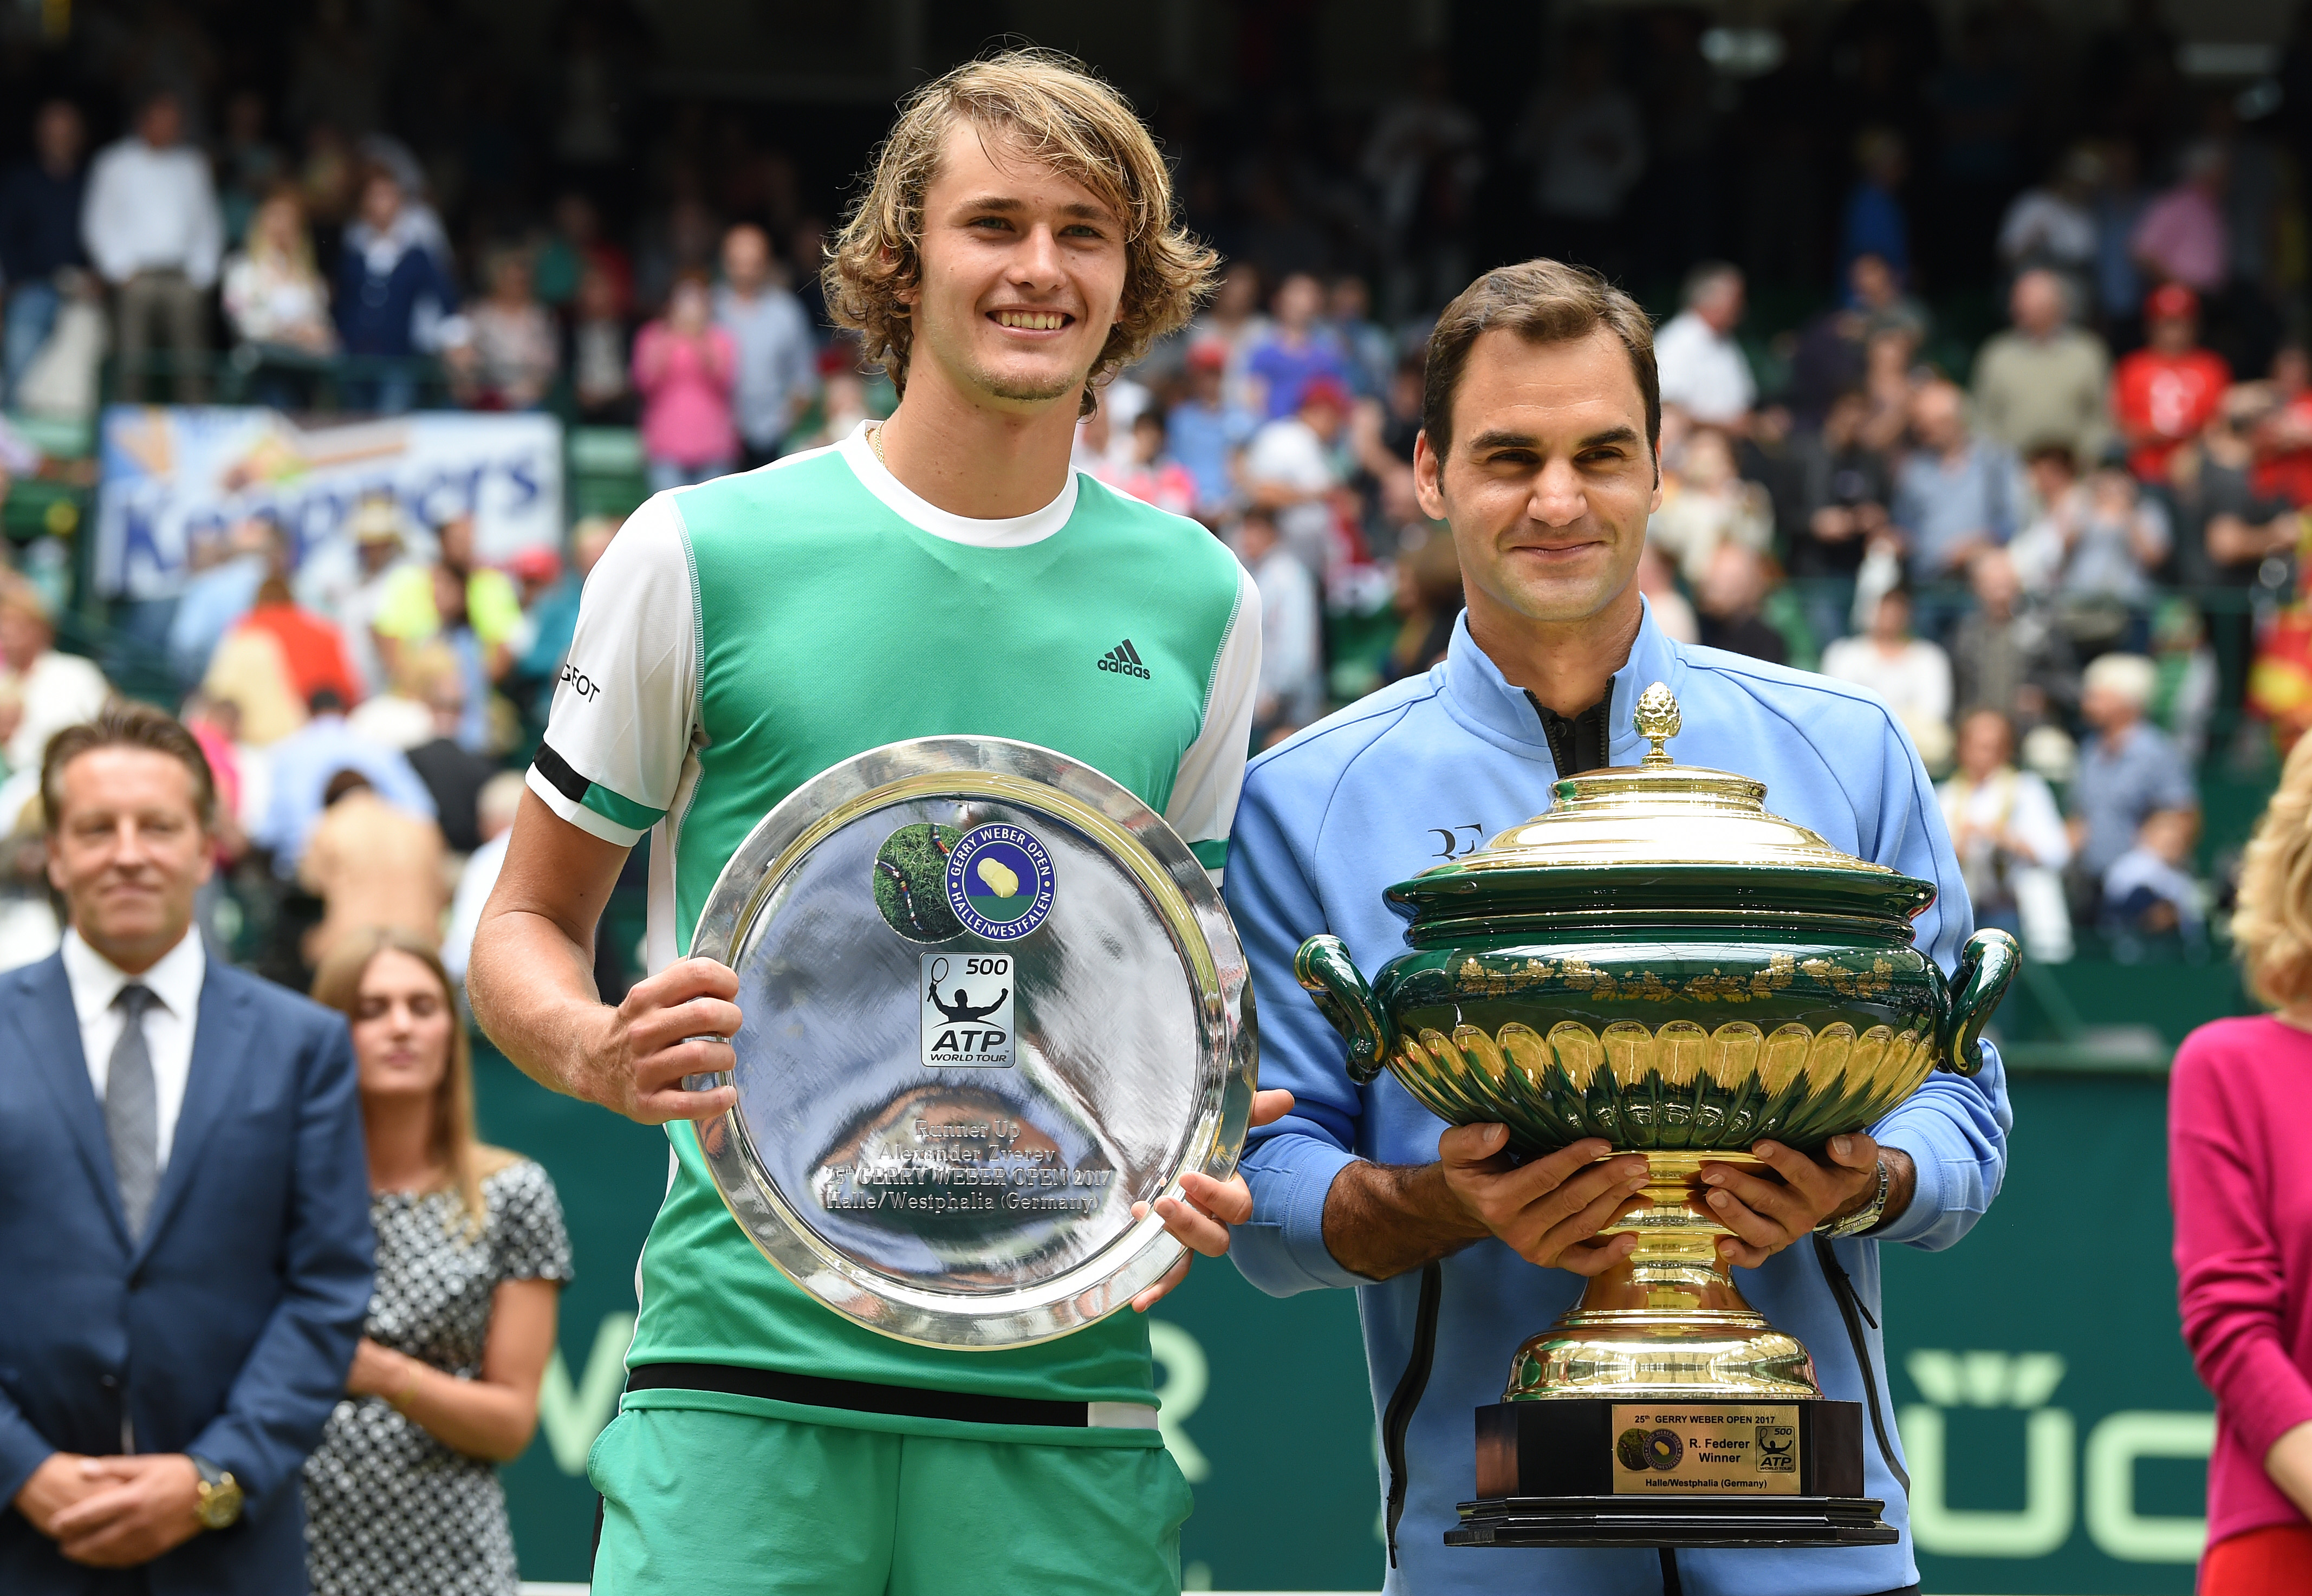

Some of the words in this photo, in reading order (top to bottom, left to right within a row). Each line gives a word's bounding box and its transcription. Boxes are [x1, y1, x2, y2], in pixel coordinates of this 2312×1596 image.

[1097, 659, 1151, 680] adidas
[950, 835, 978, 877] GERRY
[979, 827, 1026, 845] WEBER
[1027, 841, 1051, 876] OPEN
[951, 891, 1052, 937] HALLE/WESTFALEN
[965, 958, 1008, 975] 500
[931, 1030, 1006, 1052] ATP
[930, 1054, 973, 1062] WORLD
[975, 1054, 1007, 1062] TOUR
[915, 1119, 989, 1138] Runner
[994, 1119, 1021, 1142] Up
[878, 1143, 981, 1162] Alexander
[989, 1144, 1056, 1162] Zverev
[858, 1167, 928, 1185] GERRY
[932, 1167, 1007, 1185] WEBER
[1012, 1168, 1067, 1185] OPEN
[1074, 1170, 1110, 1185] 2017
[827, 1191, 995, 1214] Halle/Westphalia
[1001, 1192, 1099, 1214] (Germany)
[1634, 1415, 1651, 1423] 25th
[1655, 1416, 1687, 1424] GERRY
[1690, 1416, 1724, 1424] WEBER
[1726, 1416, 1752, 1424] OPEN
[1755, 1416, 1776, 1424] 2017
[1689, 1439, 1701, 1449] R.
[1705, 1439, 1750, 1449] Federer
[1699, 1452, 1741, 1463] Winner
[1760, 1457, 1792, 1466] ATP
[1646, 1478, 1718, 1488] Halle/Westphalia
[1720, 1478, 1767, 1489] (Germany)
